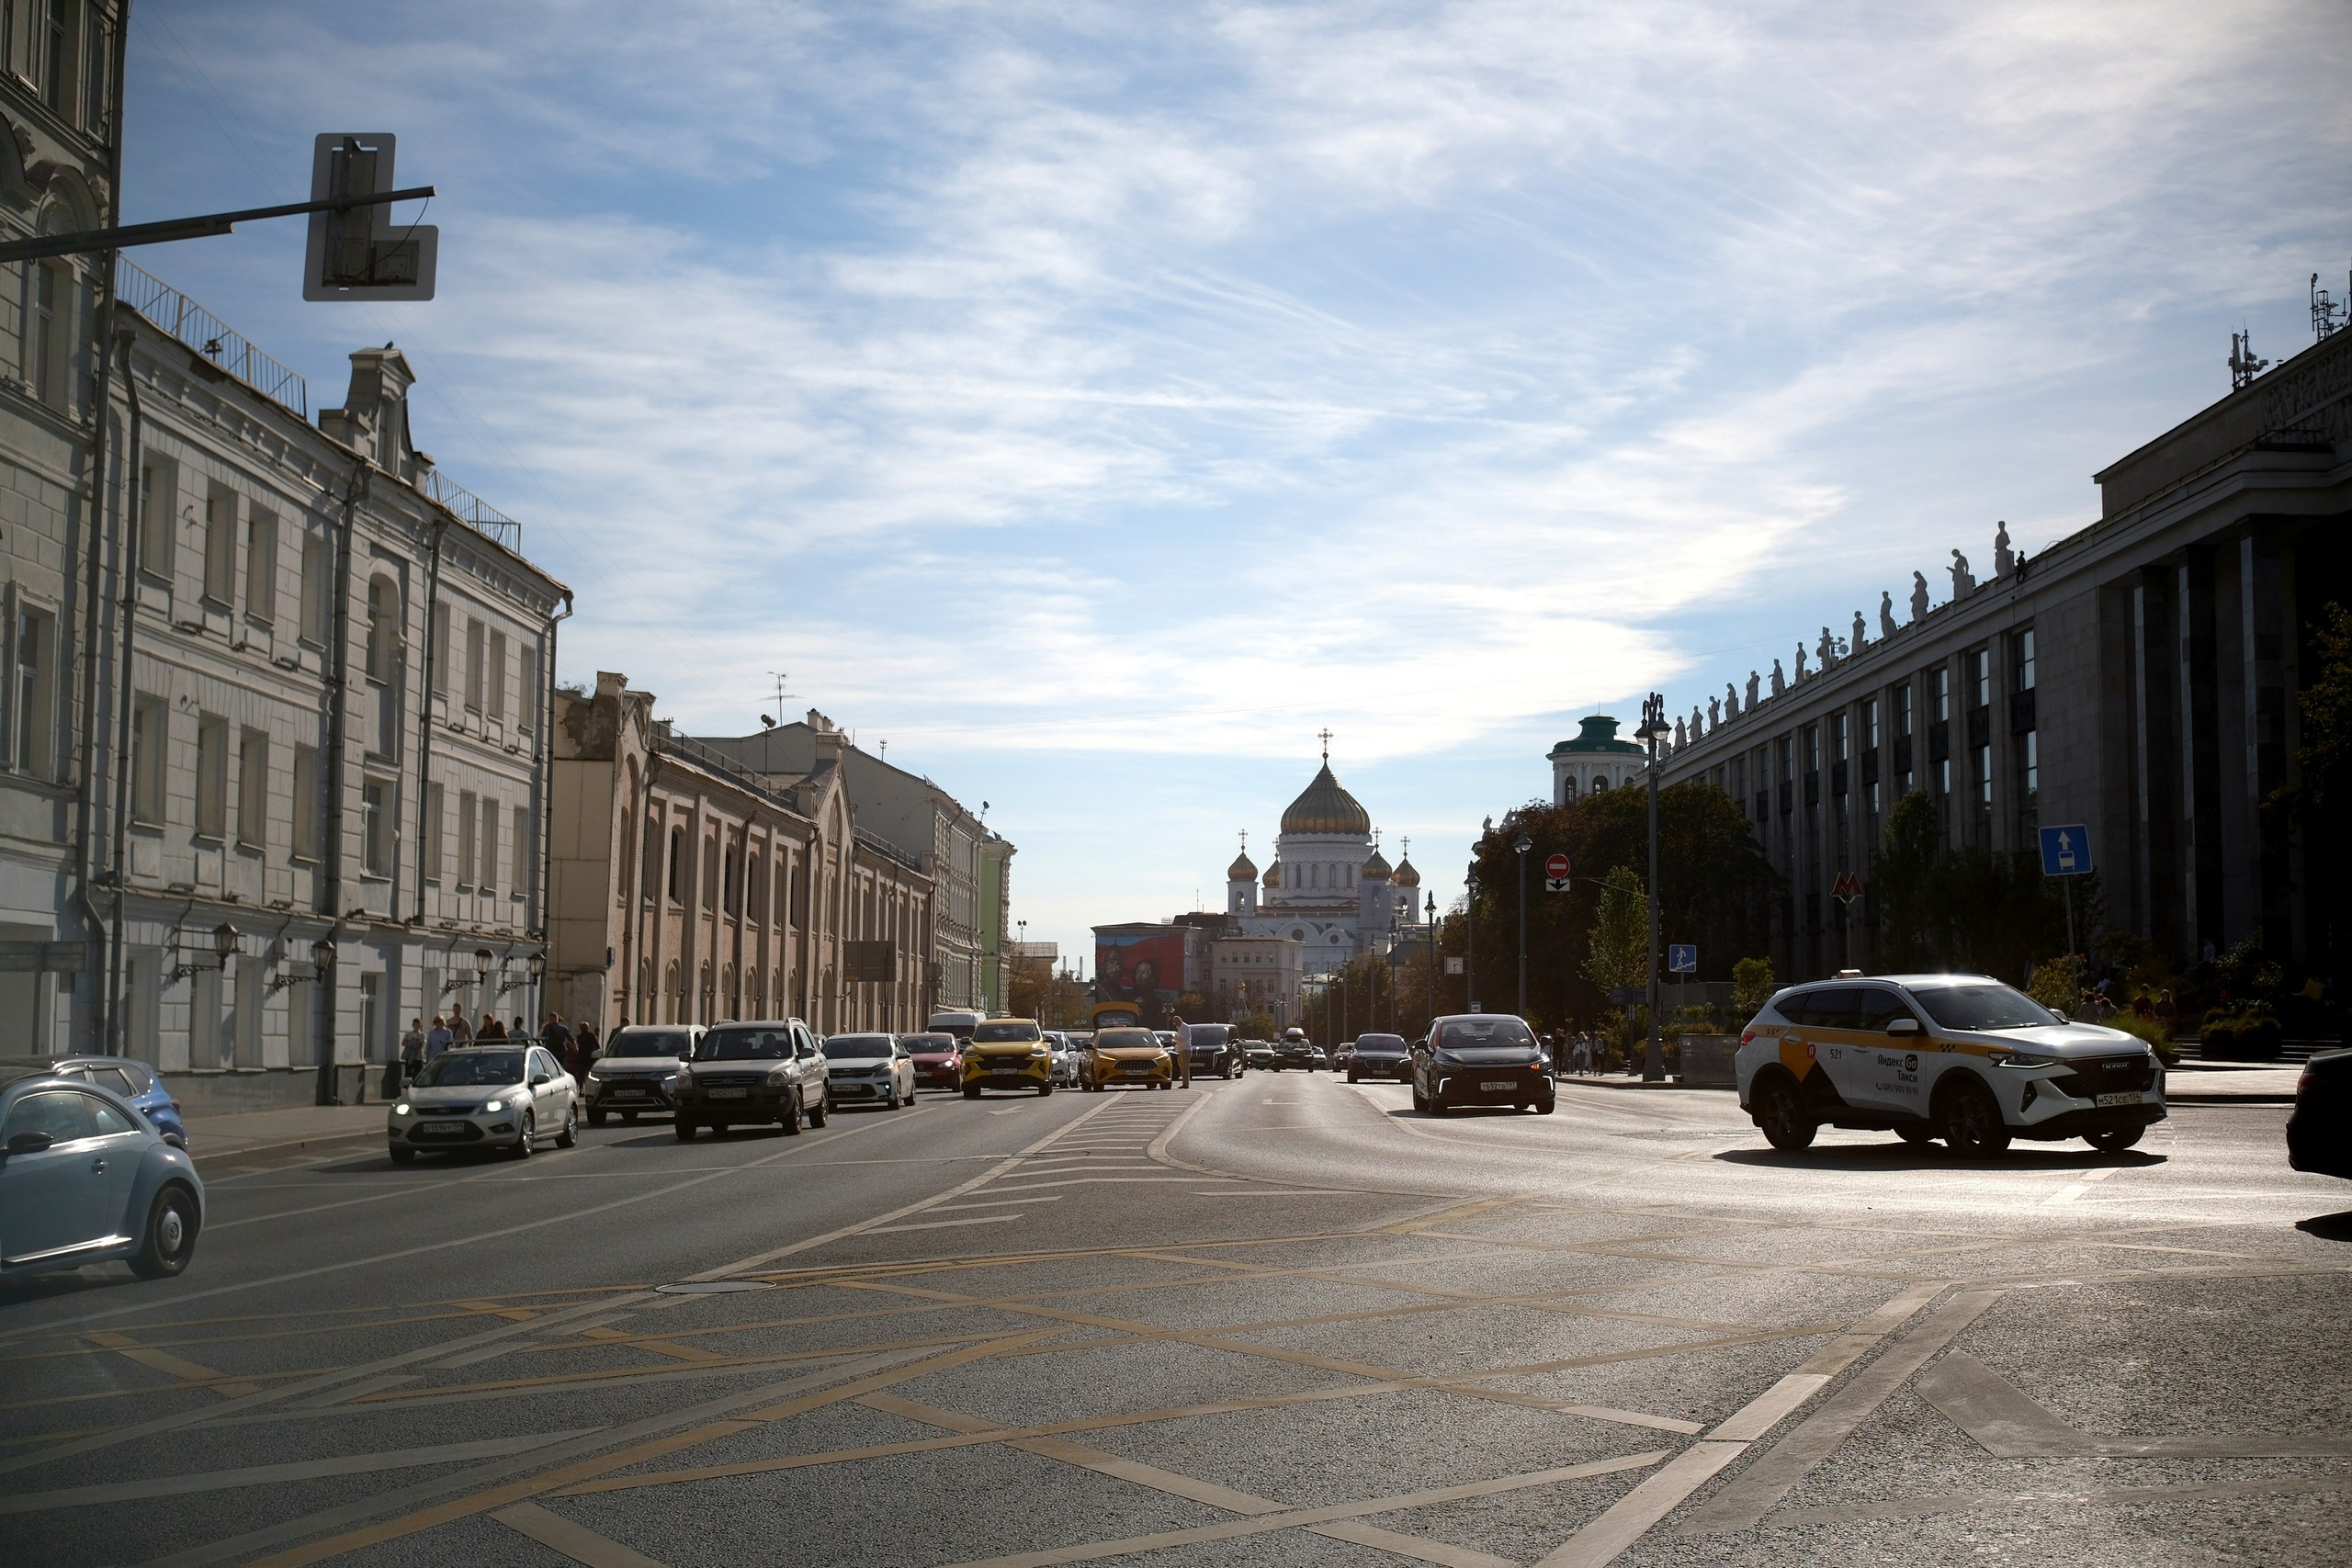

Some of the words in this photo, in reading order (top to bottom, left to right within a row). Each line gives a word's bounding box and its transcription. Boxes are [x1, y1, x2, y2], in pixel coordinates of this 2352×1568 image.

[1829, 1049, 1842, 1059] 521
[1877, 1055, 1904, 1067] Яндекс
[1905, 1056, 1917, 1069] Go
[1896, 1069, 1917, 1083] Такси
[1881, 1083, 1894, 1092] (495)
[1894, 1085, 1905, 1094] 999
[1905, 1086, 1912, 1095] 99
[1912, 1087, 1919, 1096] 99
[2098, 1095, 2127, 1106] М521СЕ
